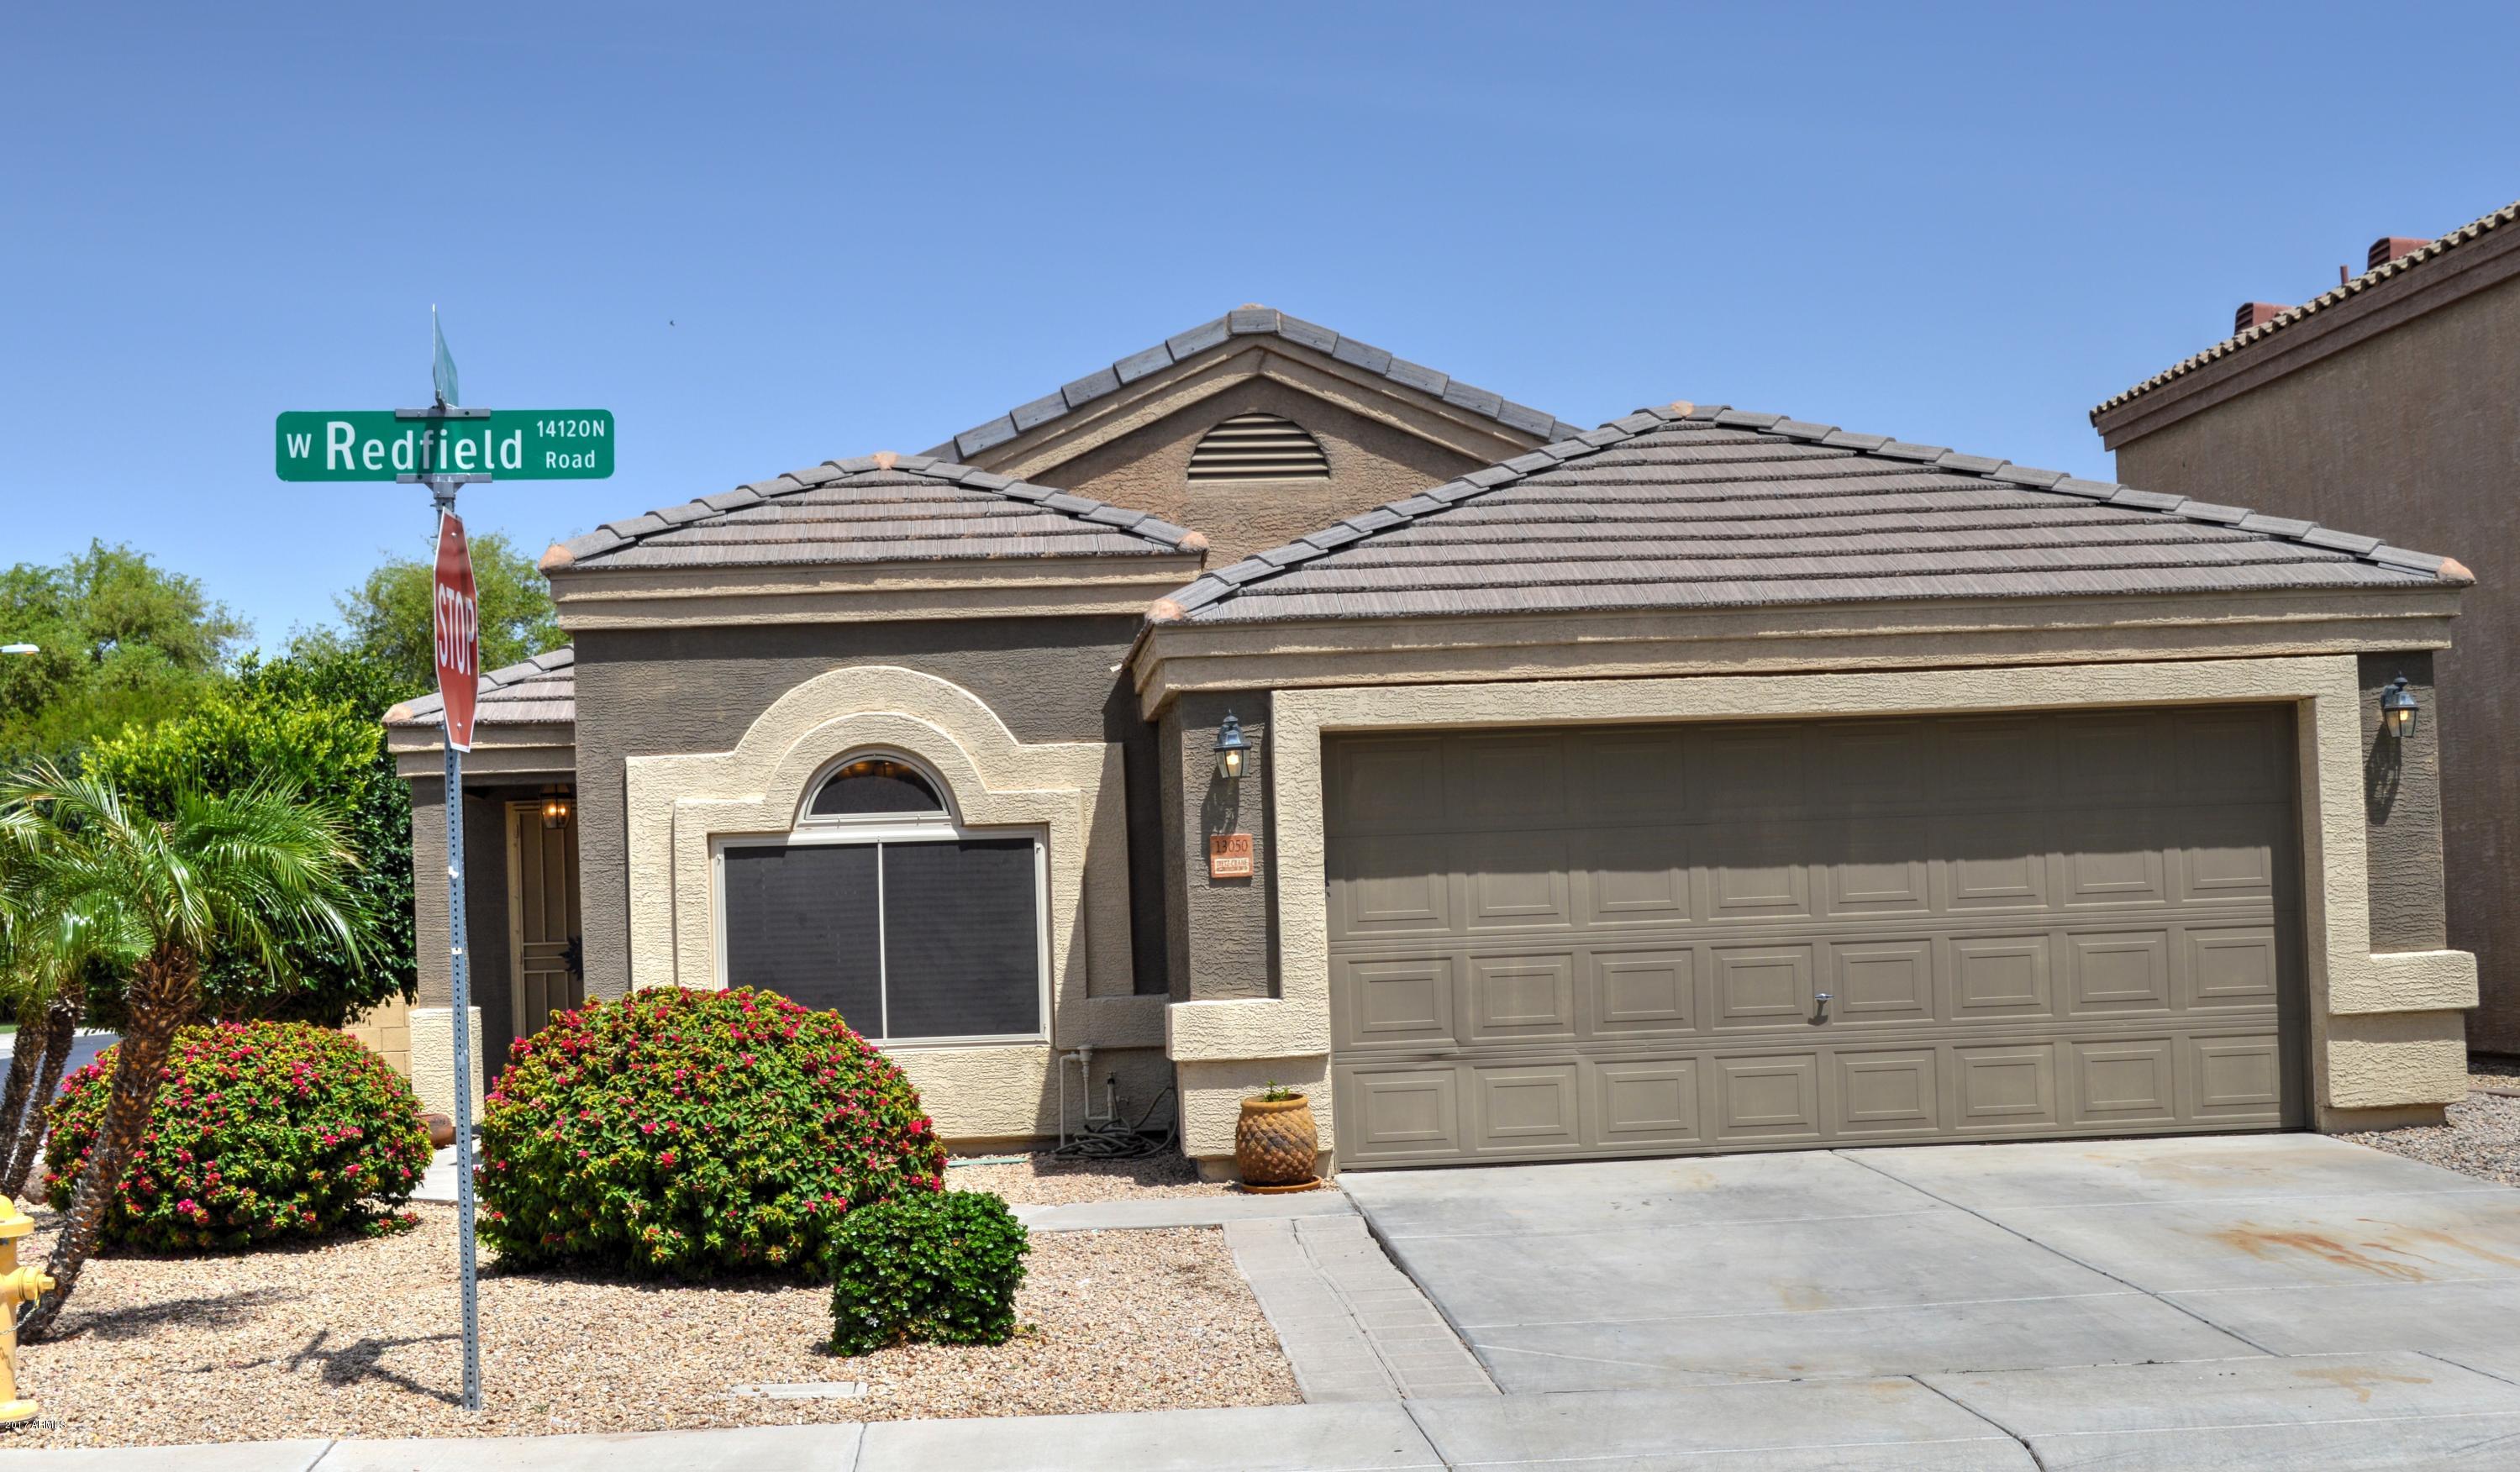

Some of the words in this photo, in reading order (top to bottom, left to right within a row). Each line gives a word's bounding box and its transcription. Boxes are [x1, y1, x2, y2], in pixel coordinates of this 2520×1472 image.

[537, 420, 605, 438] 14120N
[287, 434, 312, 459] W
[326, 421, 523, 471] Redfield
[545, 450, 596, 469] Road
[439, 582, 475, 676] STOP
[1216, 839, 1248, 854] 13050
